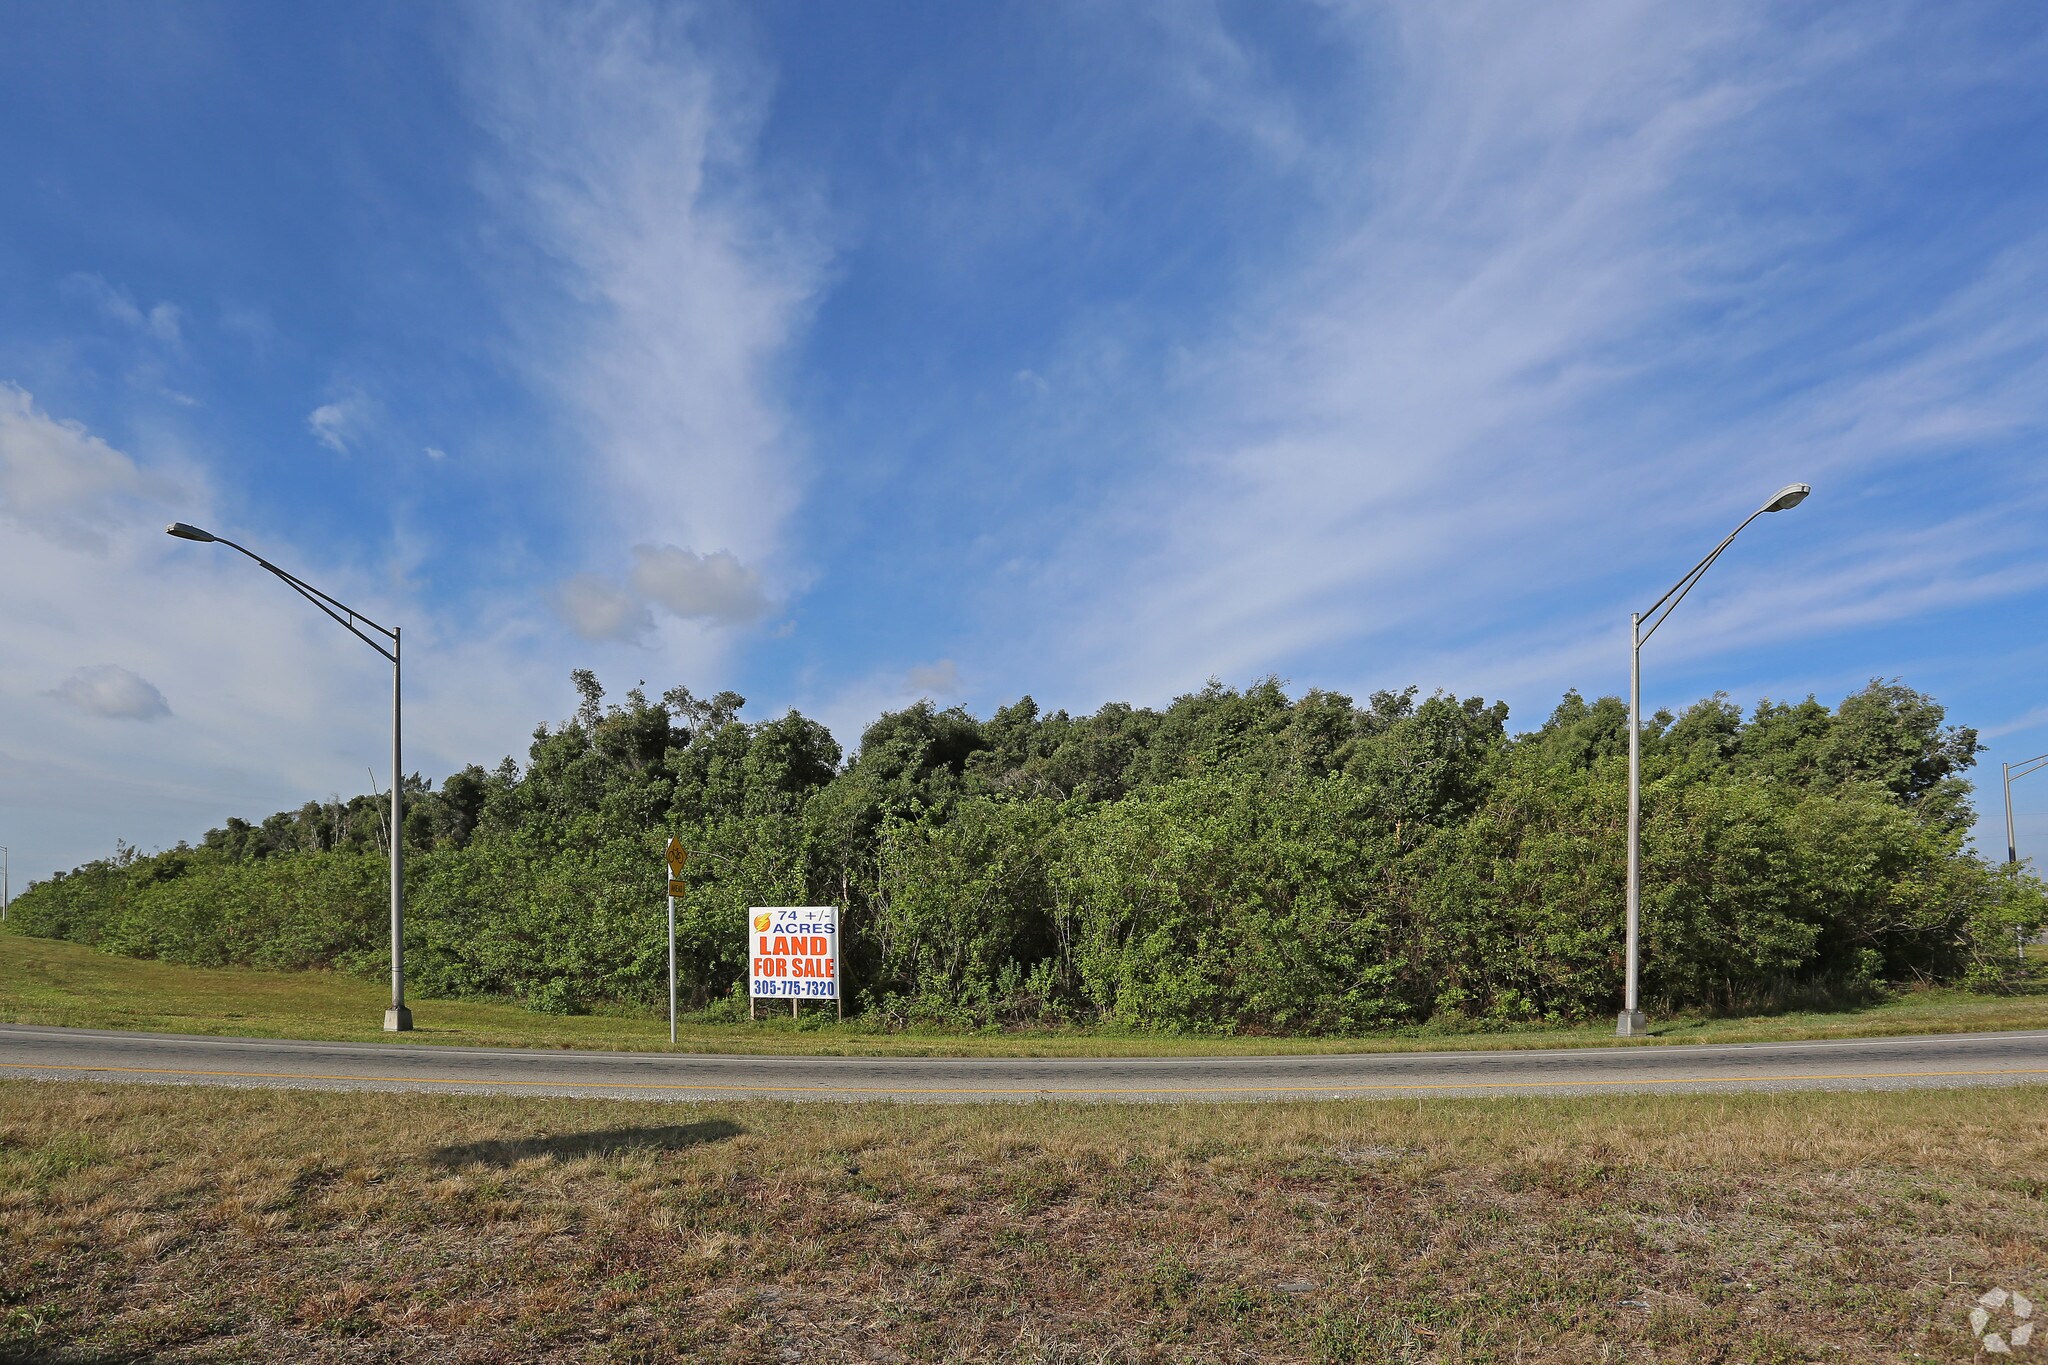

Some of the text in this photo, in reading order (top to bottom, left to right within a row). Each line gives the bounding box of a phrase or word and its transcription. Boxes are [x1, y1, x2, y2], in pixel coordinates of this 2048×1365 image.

[778, 910, 830, 921] 74 +/-
[773, 923, 836, 934] ACRES
[759, 936, 828, 956] LAND
[753, 957, 835, 978] FOR SALE
[754, 980, 835, 996] 305-775-7320
